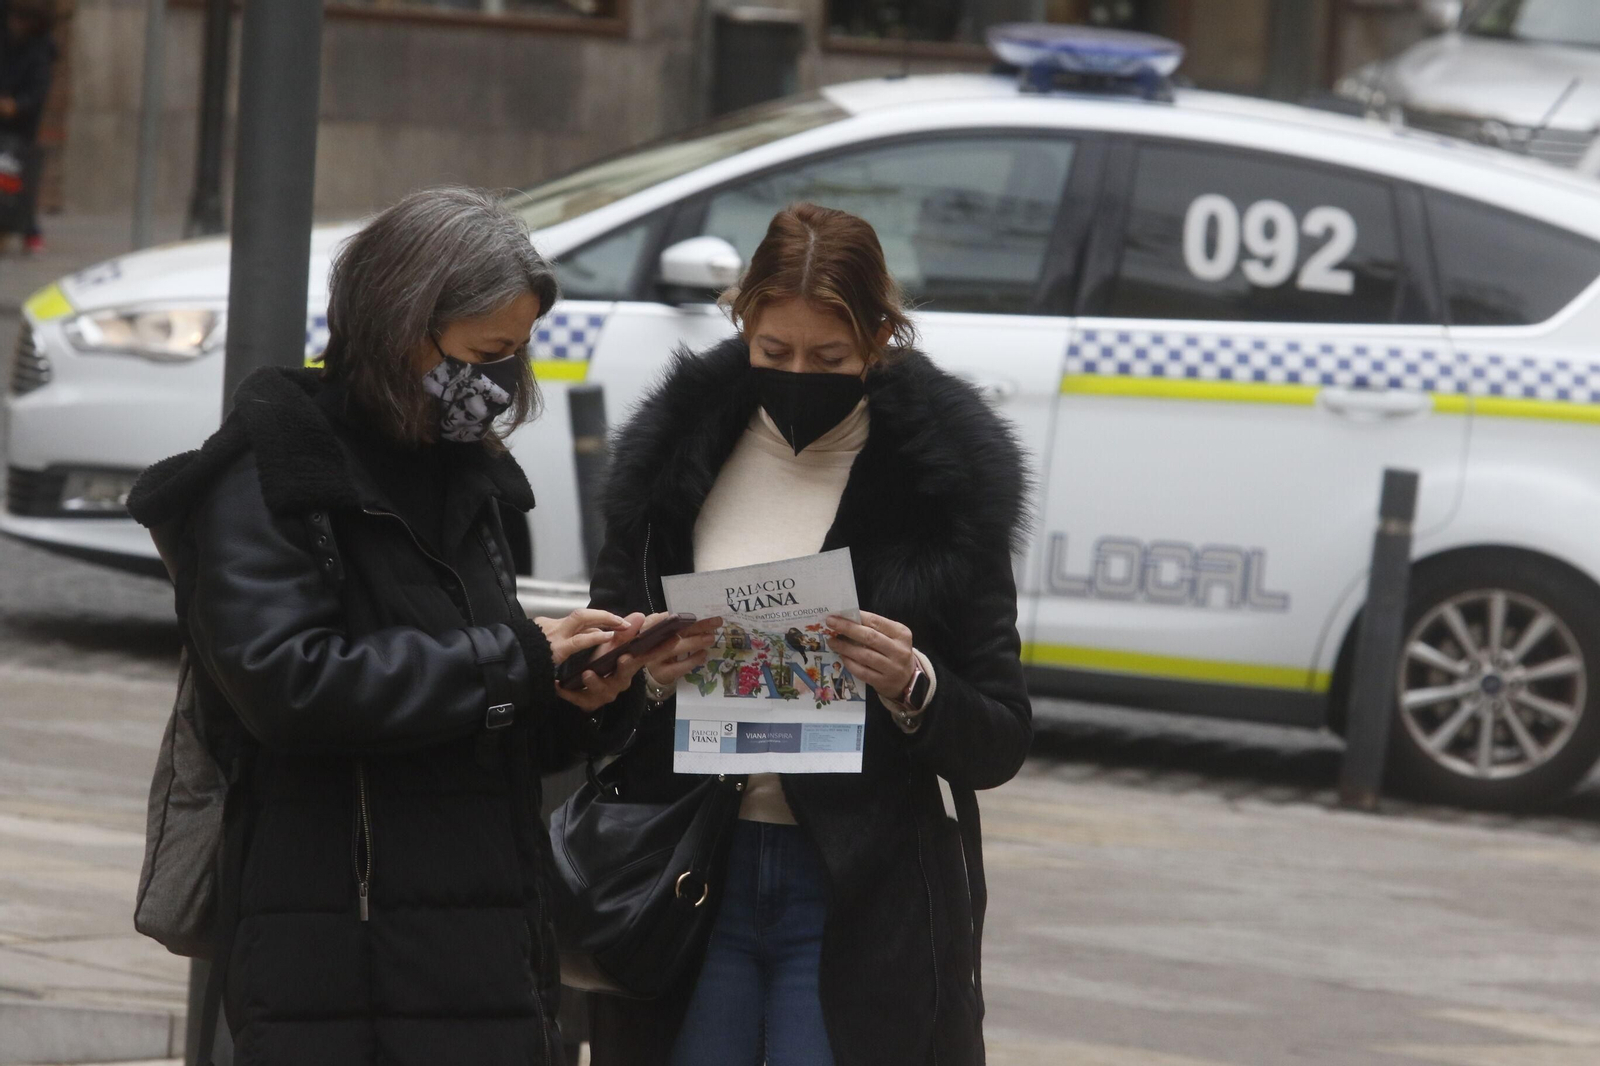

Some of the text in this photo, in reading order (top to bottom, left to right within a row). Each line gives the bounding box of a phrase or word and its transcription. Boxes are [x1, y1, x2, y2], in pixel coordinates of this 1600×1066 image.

[1183, 193, 1357, 295] 092
[725, 578, 796, 599] PALACIO
[1048, 531, 1292, 613] LOCAL
[728, 592, 799, 613] VIANA
